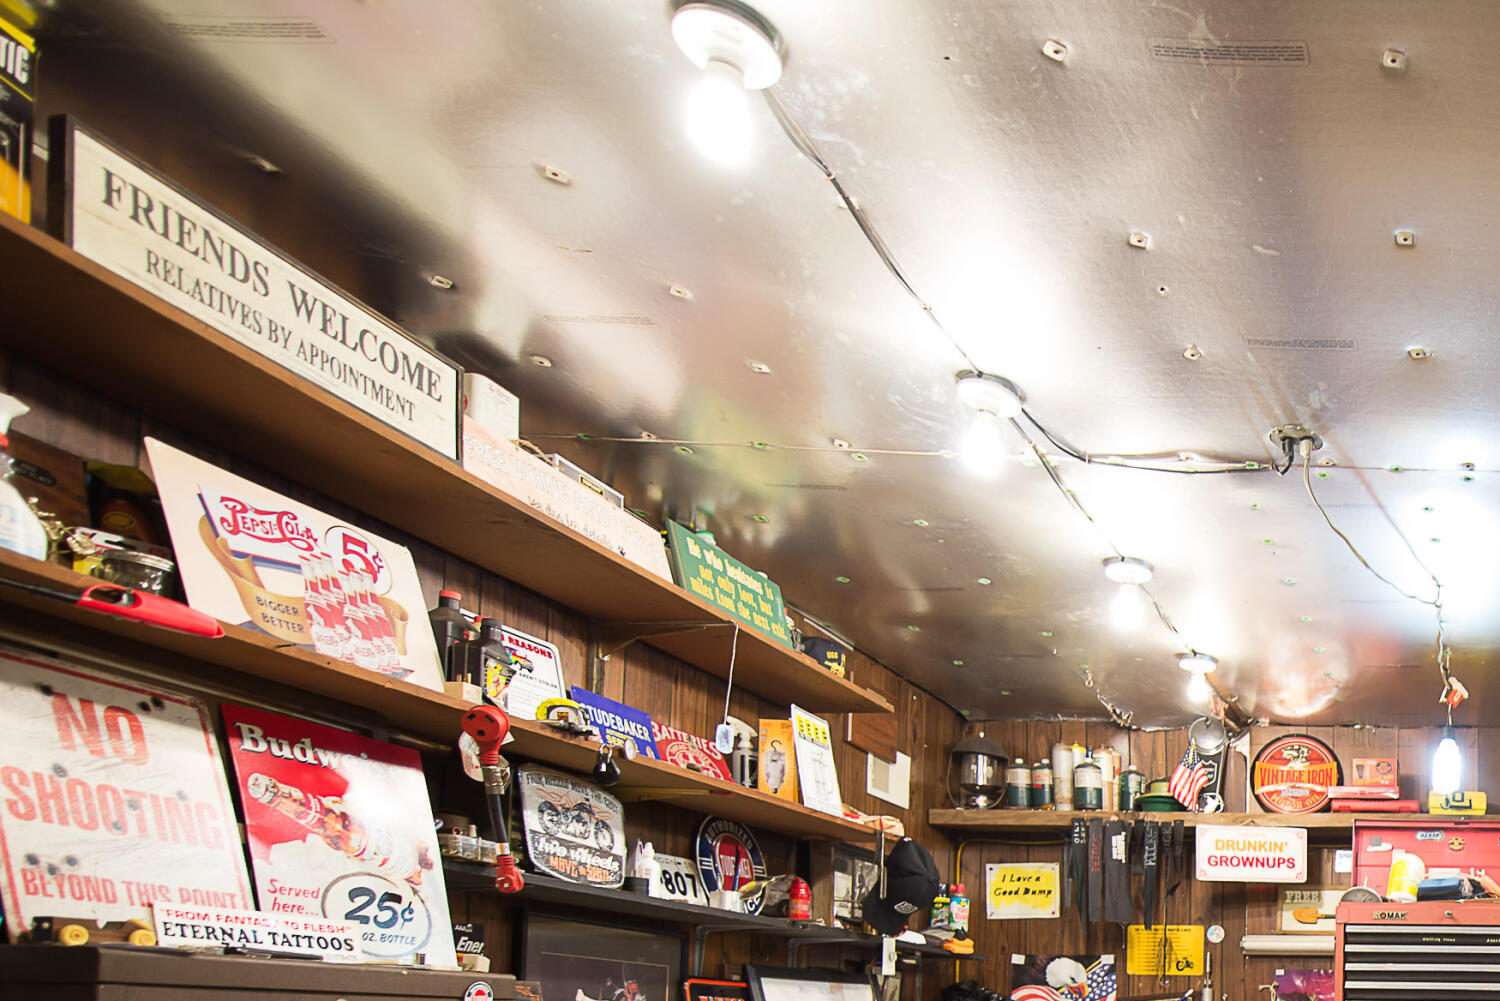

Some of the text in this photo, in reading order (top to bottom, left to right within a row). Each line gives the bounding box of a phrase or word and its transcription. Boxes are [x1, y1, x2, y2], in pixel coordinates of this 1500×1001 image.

[101, 166, 443, 403] FRIENDS WELCOME
[145, 249, 416, 422] RELATIVES BY APPOINTMENT
[686, 536, 774, 601] He who hesitates is
[689, 576, 714, 600] miles
[715, 586, 737, 613] from
[737, 601, 751, 620] the
[698, 564, 715, 584] not
[717, 575, 736, 600] only
[758, 595, 773, 617] but
[256, 595, 300, 617] BIGGER
[261, 611, 305, 633] BETTER
[508, 634, 553, 660] REASONS
[50, 693, 147, 766] NO
[650, 720, 722, 760] BATTERIES
[1259, 766, 1333, 788] VINTAGE IRON
[0, 764, 225, 851] SHOOTING
[1214, 838, 1289, 853] DRUNKIN'
[1207, 855, 1296, 869] GROWNUPS
[19, 866, 239, 910] BEYOND THIS POINT
[268, 877, 321, 900] Served
[660, 868, 699, 899] 807
[1009, 873, 1033, 883] Love
[993, 887, 1053, 898] Good Dump
[1285, 890, 1320, 904] FREE
[162, 921, 355, 952] ETERNAL TATTOOS
[283, 920, 300, 930] TO
[379, 932, 417, 945] BOTTLE
